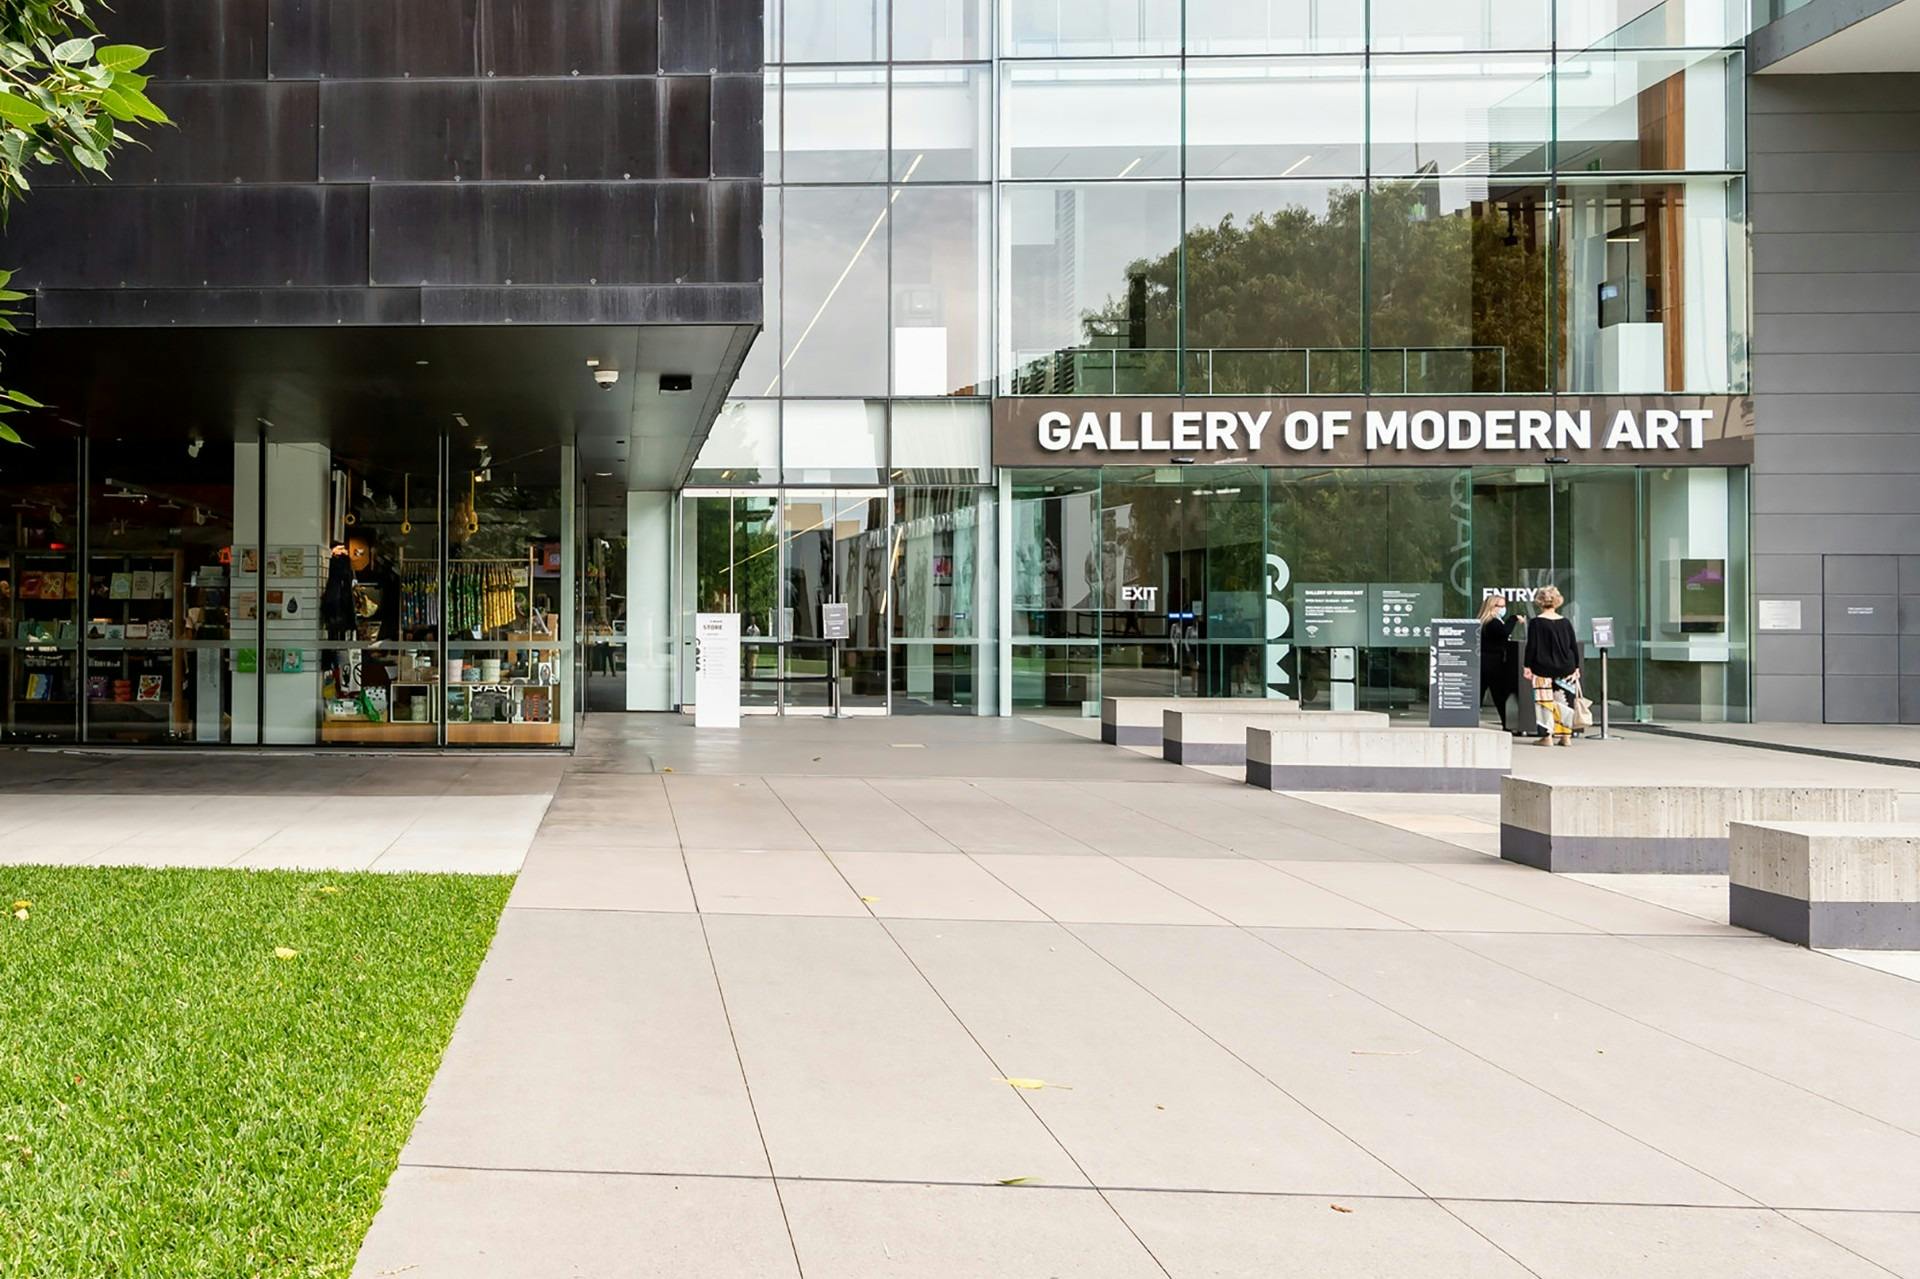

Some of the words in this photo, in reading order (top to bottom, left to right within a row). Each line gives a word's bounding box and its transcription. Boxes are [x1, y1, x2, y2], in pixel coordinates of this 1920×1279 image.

[1038, 411, 1272, 450] GALLERY
[1284, 411, 1352, 450] OF
[1366, 410, 1591, 450] MODERN
[1605, 409, 1714, 449] ART
[1121, 586, 1158, 600] EXIT
[1482, 587, 1538, 602] ENTRY
